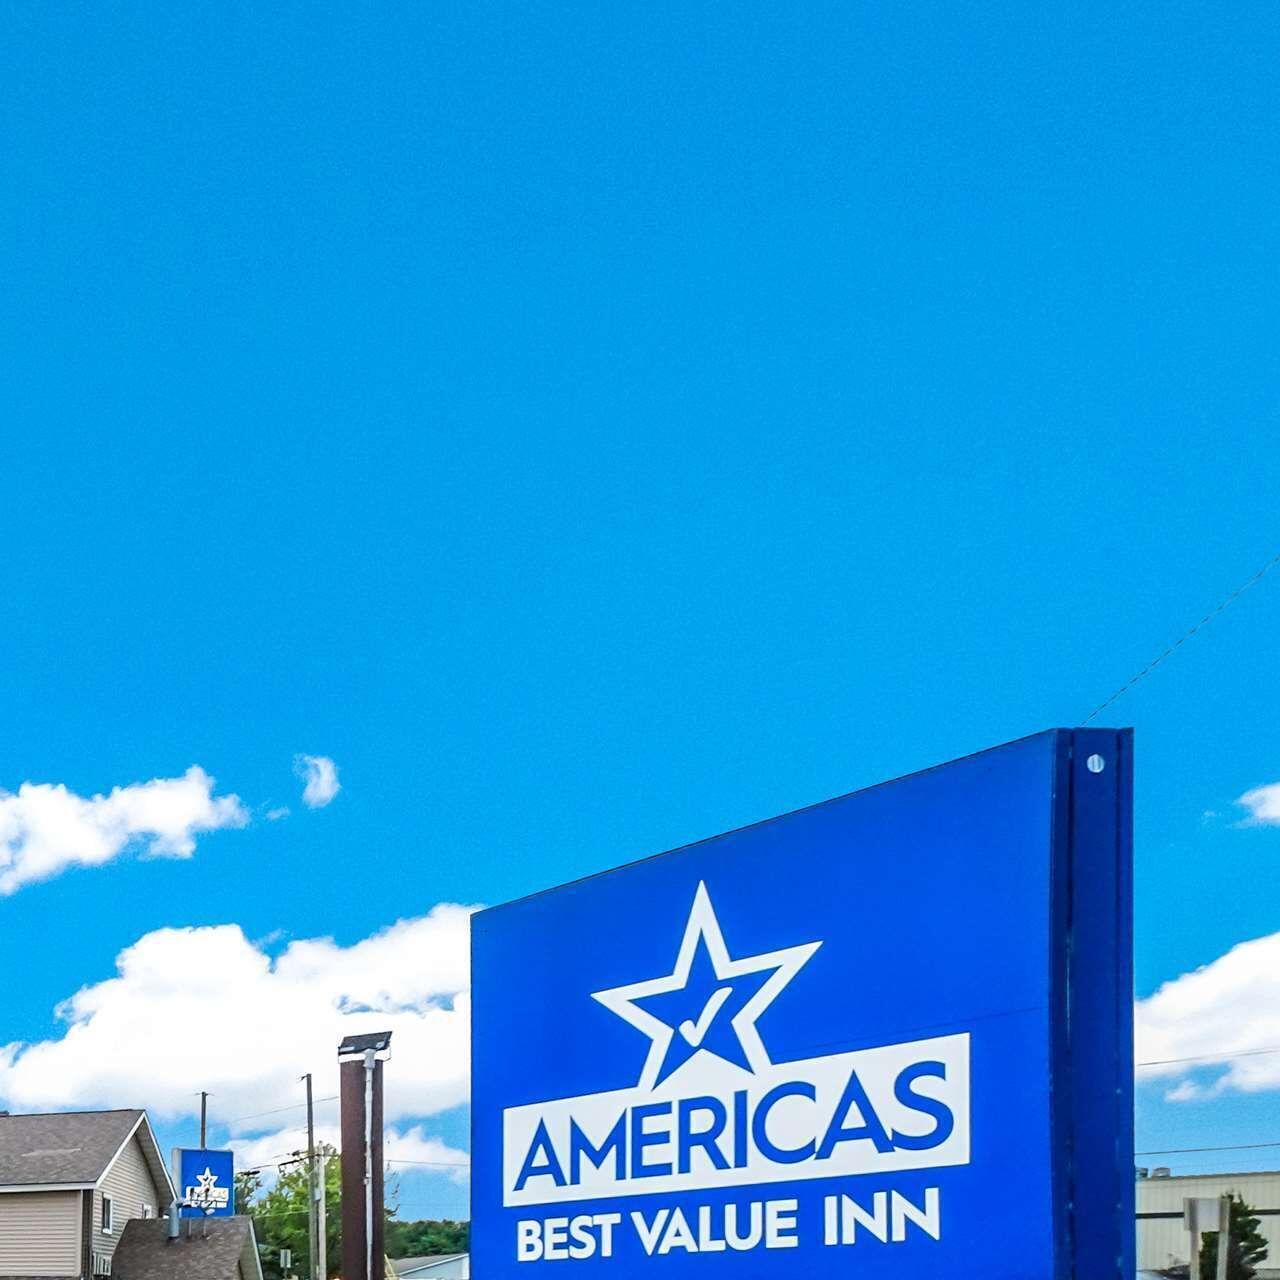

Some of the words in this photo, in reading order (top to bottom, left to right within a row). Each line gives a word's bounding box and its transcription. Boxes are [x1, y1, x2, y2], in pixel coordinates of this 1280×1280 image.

[513, 1059, 955, 1191] AMERICAS
[517, 1212, 621, 1262] BEST
[631, 1199, 799, 1255] VALUE
[824, 1187, 940, 1246] INN
